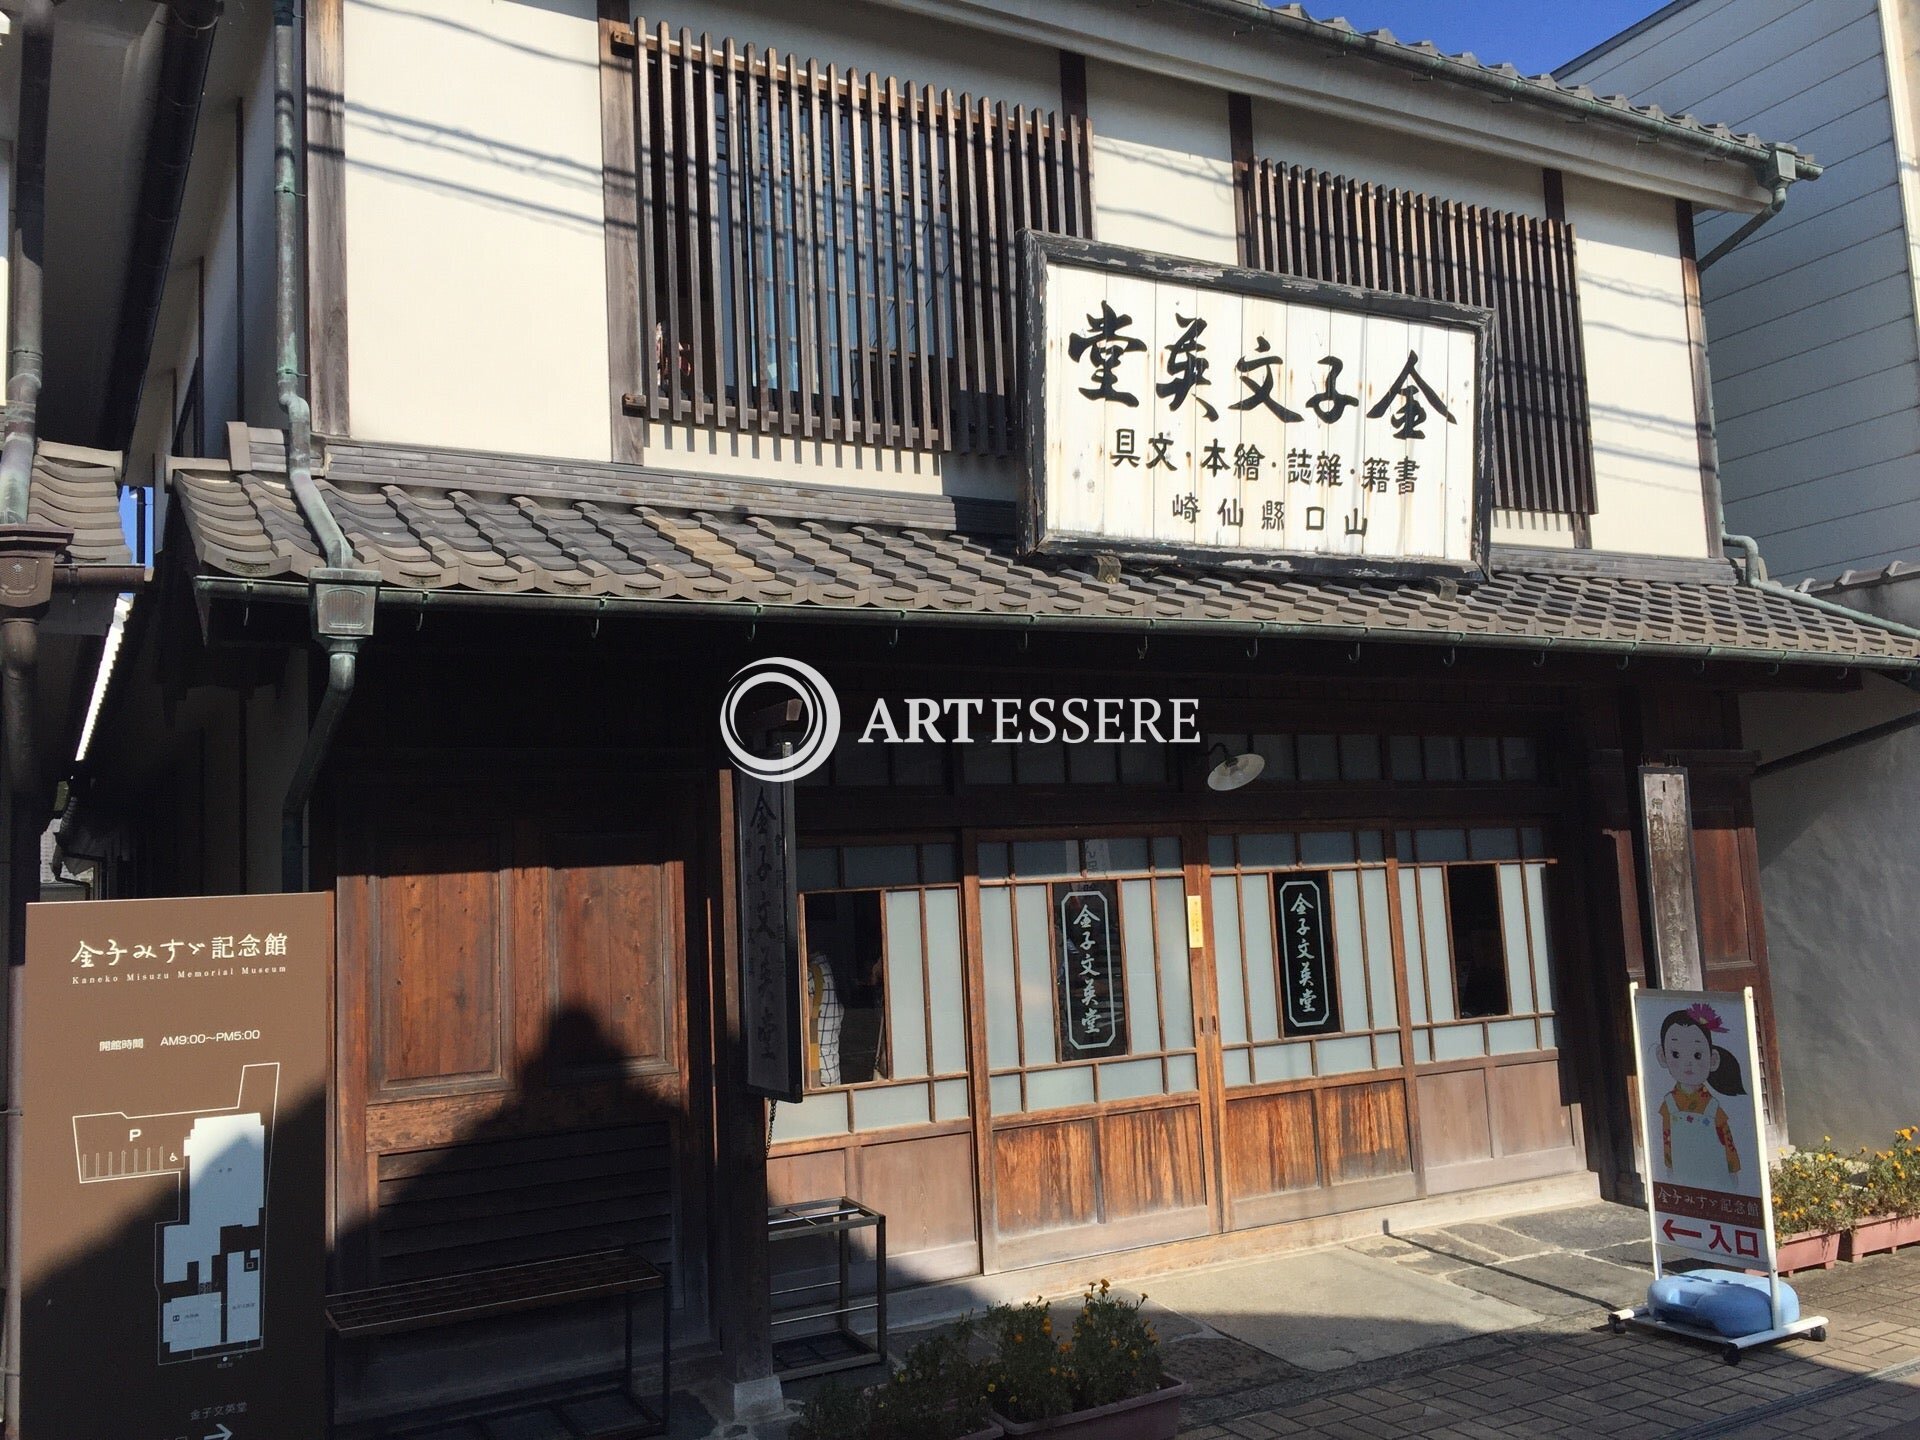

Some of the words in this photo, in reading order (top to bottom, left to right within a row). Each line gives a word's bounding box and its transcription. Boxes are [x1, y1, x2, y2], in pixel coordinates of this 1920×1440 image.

[1073, 903, 1101, 1035] 金子文英堂
[1290, 892, 1317, 1013] 金子文英堂
[72, 974, 119, 985] Kaneko
[126, 970, 170, 982] Misuzu
[177, 967, 234, 979] Memorial
[241, 965, 287, 975] Museum
[129, 1128, 142, 1142] P
[1708, 1223, 1760, 1259] 入口
